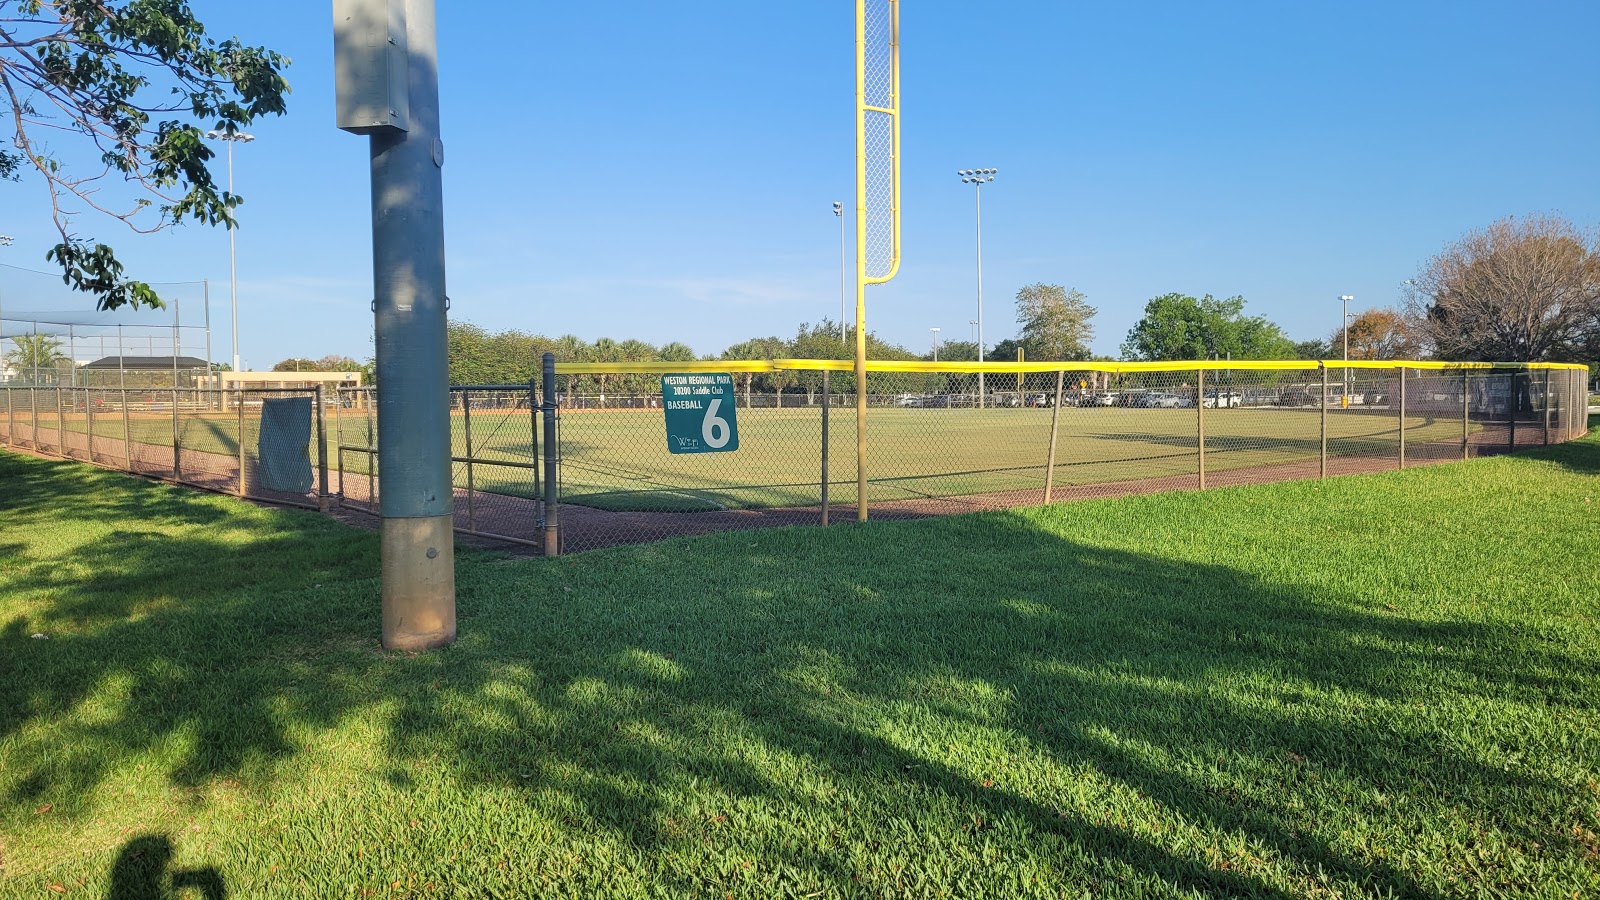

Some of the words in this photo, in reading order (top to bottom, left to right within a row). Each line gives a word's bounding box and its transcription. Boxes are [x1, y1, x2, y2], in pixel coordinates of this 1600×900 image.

[664, 376, 687, 385] WESTON
[689, 376, 715, 385] REGIONAL
[717, 376, 730, 384] PARK
[692, 387, 710, 395] Saddle
[712, 386, 723, 394] Club
[667, 400, 703, 409] BASEBALL
[702, 399, 730, 448] 6
